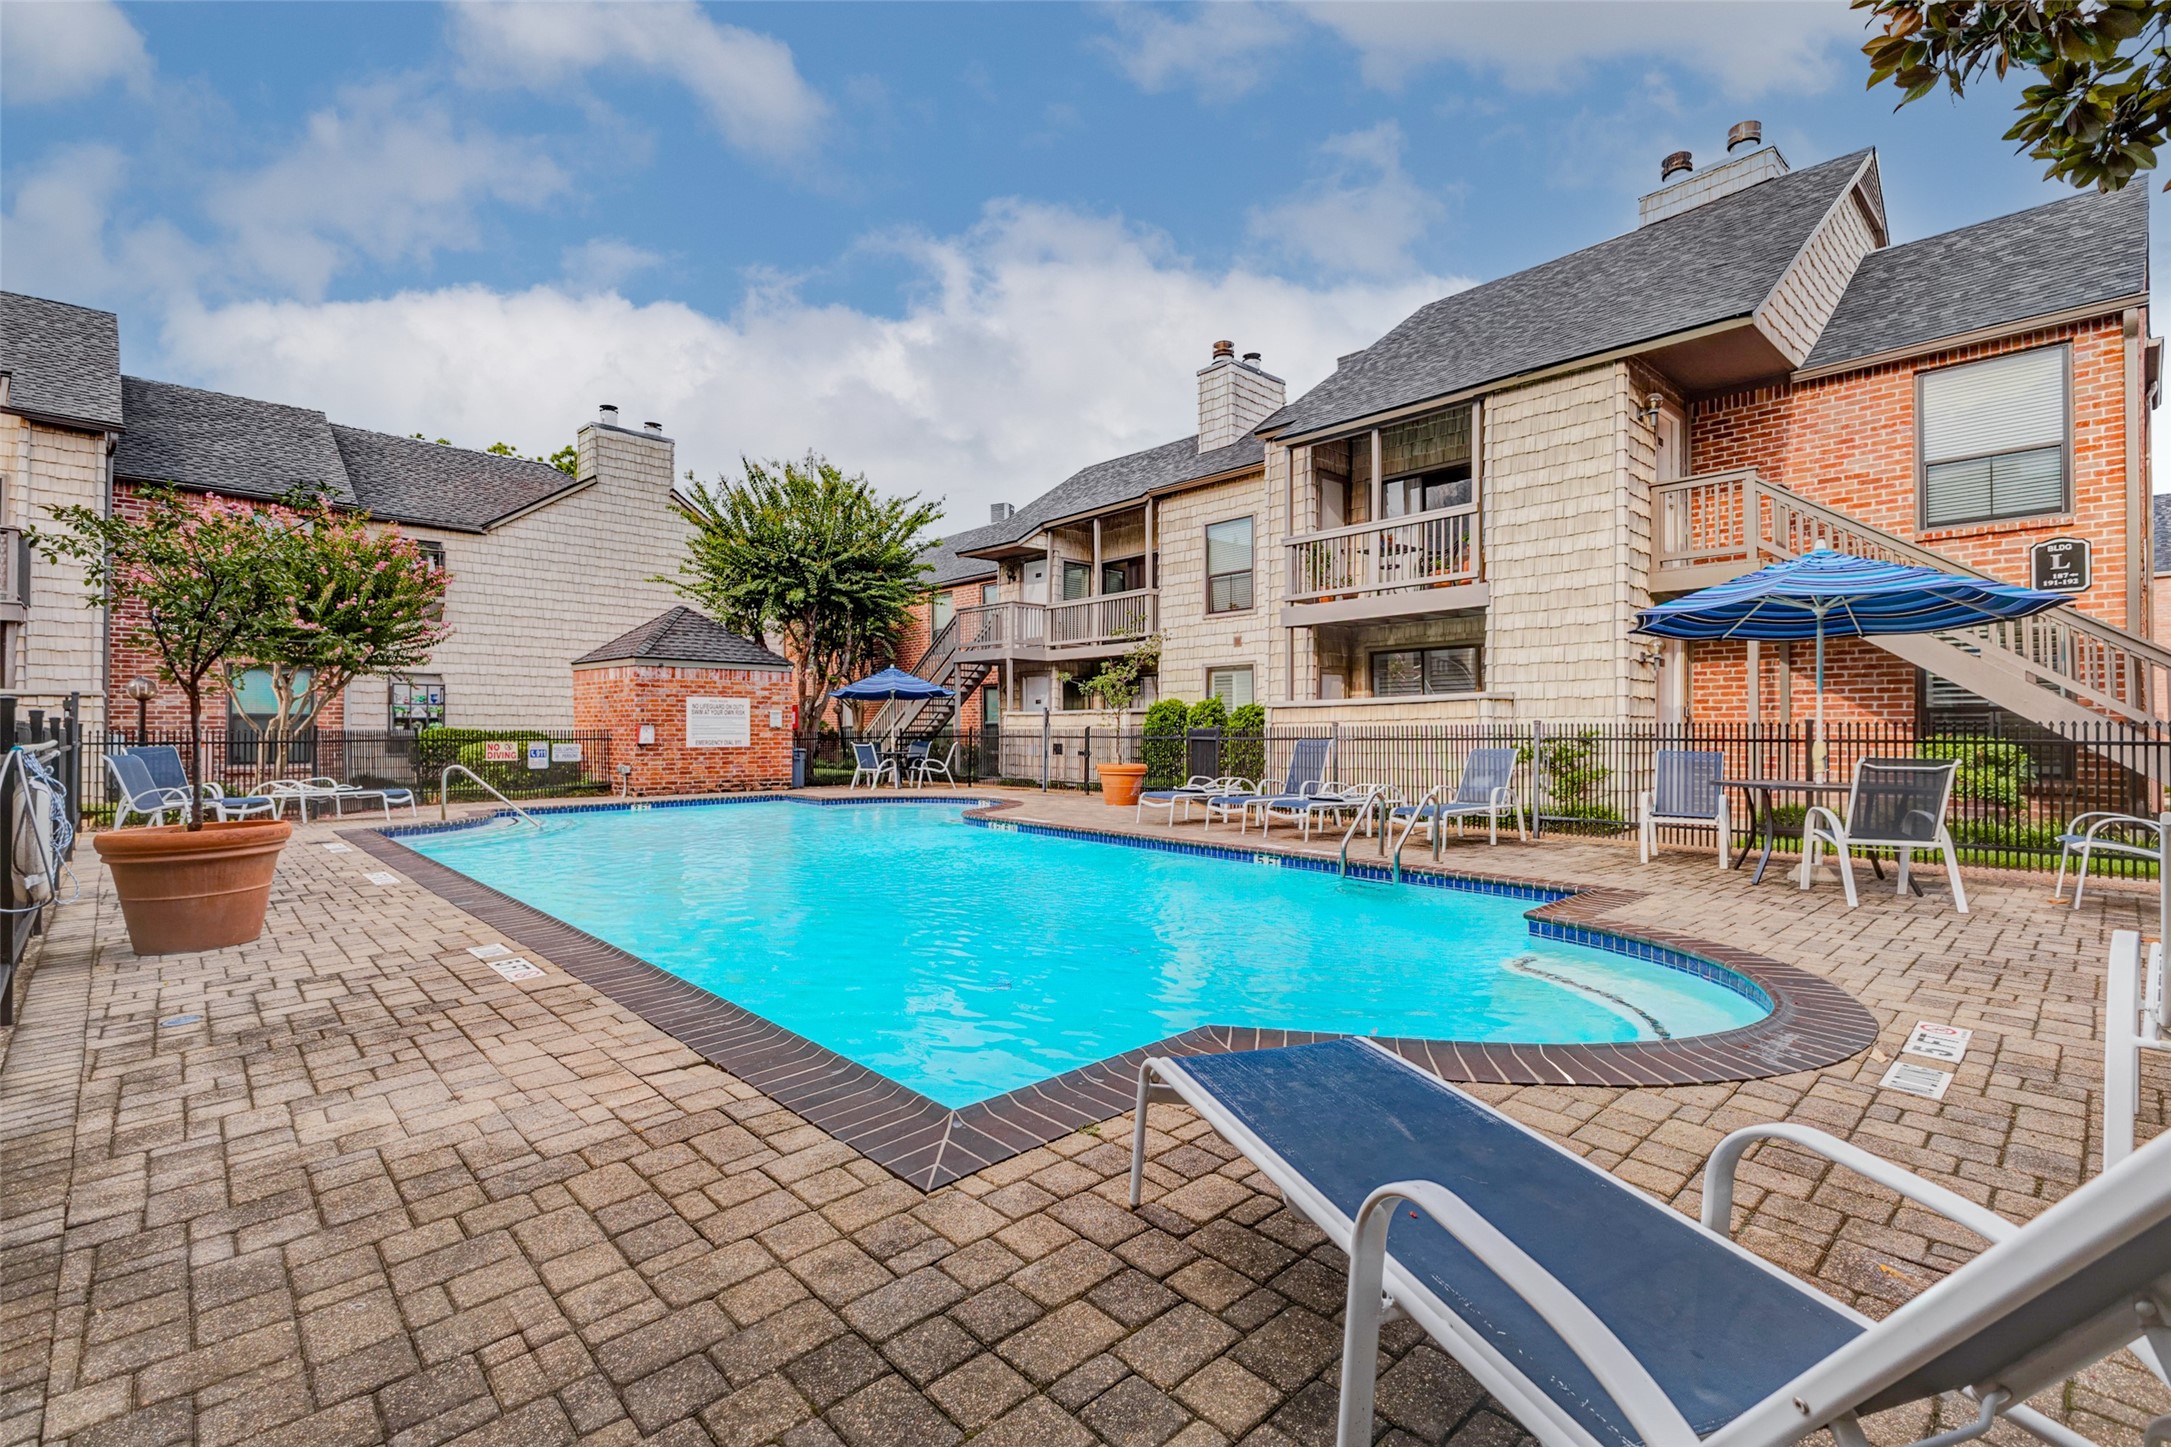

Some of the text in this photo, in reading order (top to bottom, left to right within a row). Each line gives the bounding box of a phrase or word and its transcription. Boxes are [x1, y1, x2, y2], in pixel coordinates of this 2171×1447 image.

[2047, 543, 2072, 552] BLDG
[2050, 553, 2071, 570] L
[2043, 578, 2079, 586] 191-192
[487, 743, 500, 751] NO
[487, 751, 517, 759] DIVING
[1257, 855, 1280, 866] 5 FT
